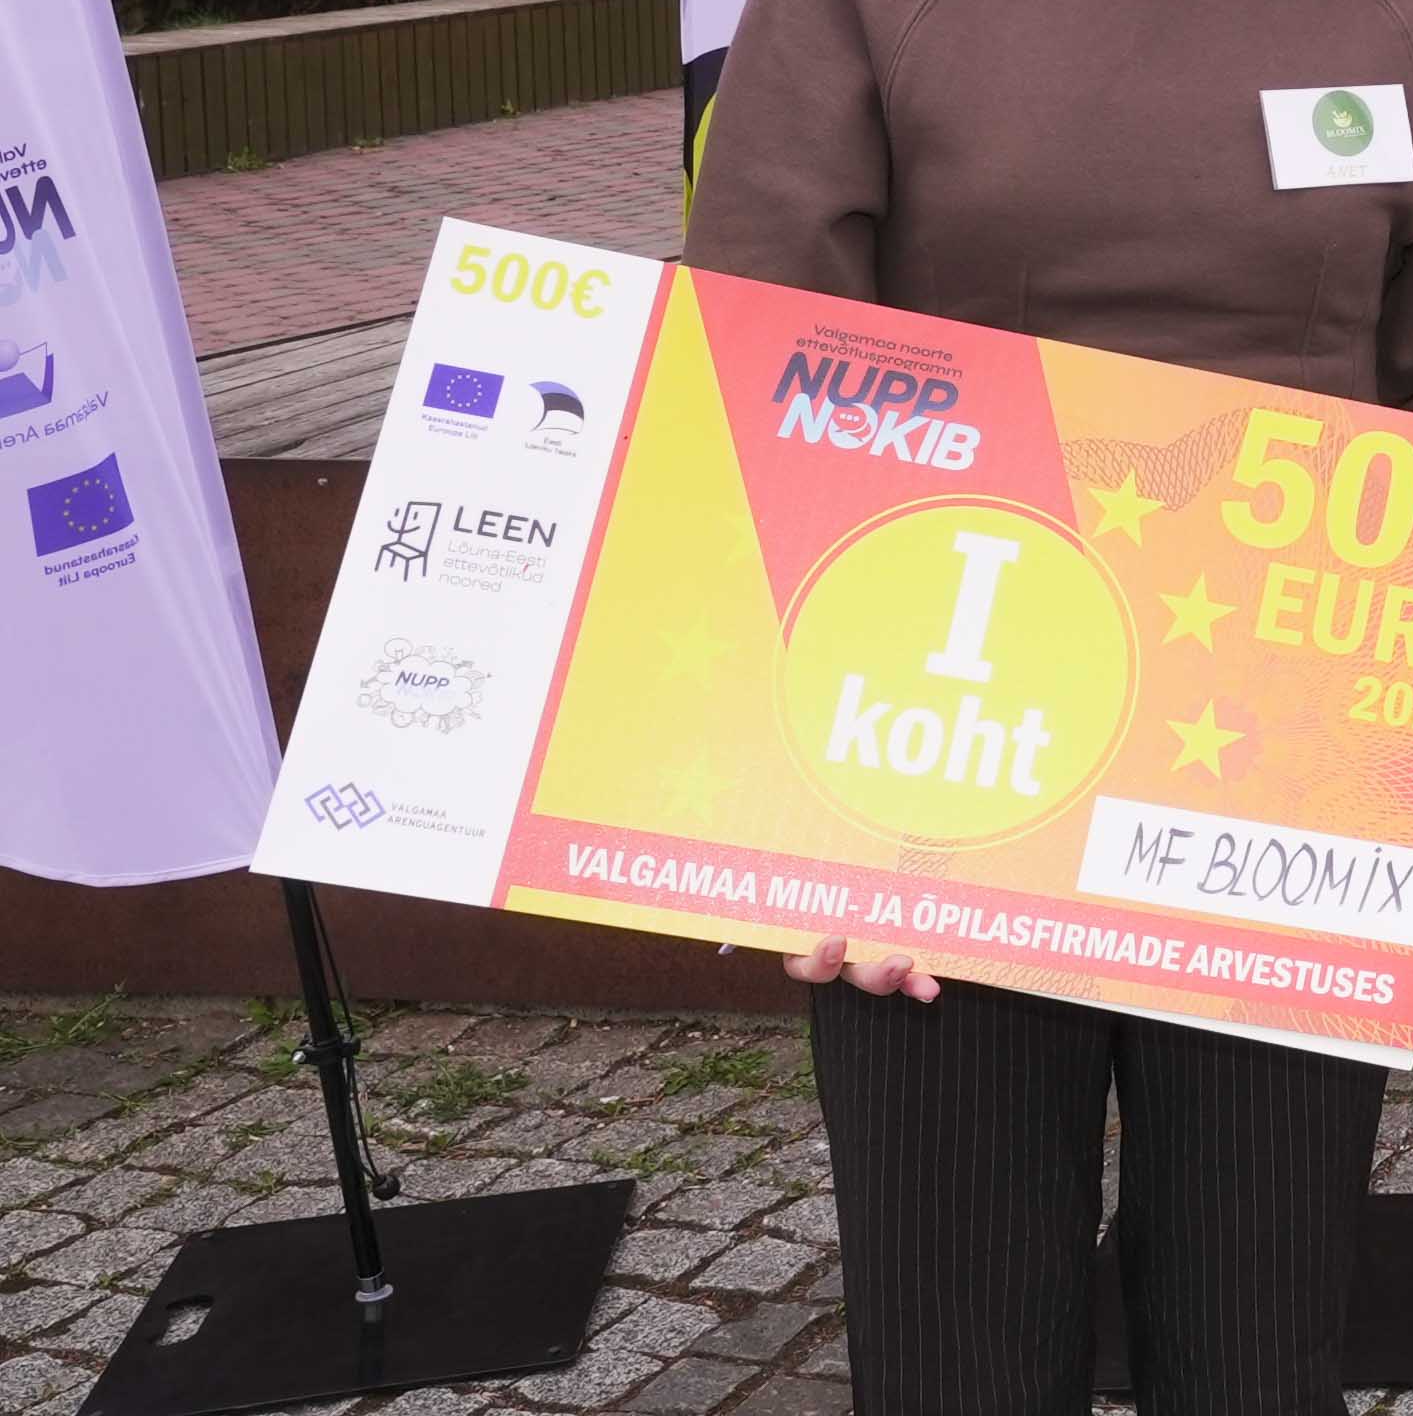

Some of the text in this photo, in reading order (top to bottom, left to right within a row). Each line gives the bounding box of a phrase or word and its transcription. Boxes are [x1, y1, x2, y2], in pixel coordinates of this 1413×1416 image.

[449, 243, 612, 319] 500€
[796, 337, 963, 378] ettevõtlusprogramm
[814, 323, 953, 362] Valgamaa noorte
[771, 351, 960, 418] NUPP
[777, 392, 982, 472] NOKIB
[453, 506, 557, 548] LEEN
[448, 540, 547, 568] Lõuna-Eesti
[438, 573, 502, 593] noored
[925, 531, 1021, 683] I
[394, 669, 450, 688] NUPP
[826, 672, 1051, 797] koht
[388, 815, 488, 838] ARENGUAGENTUUR
[391, 802, 447, 819] VALGAMAA
[1124, 820, 1196, 886] MF
[566, 842, 1396, 1005] VALGAMAA MINI- JA ÕPILASFIRMADE ARVESTUSES
